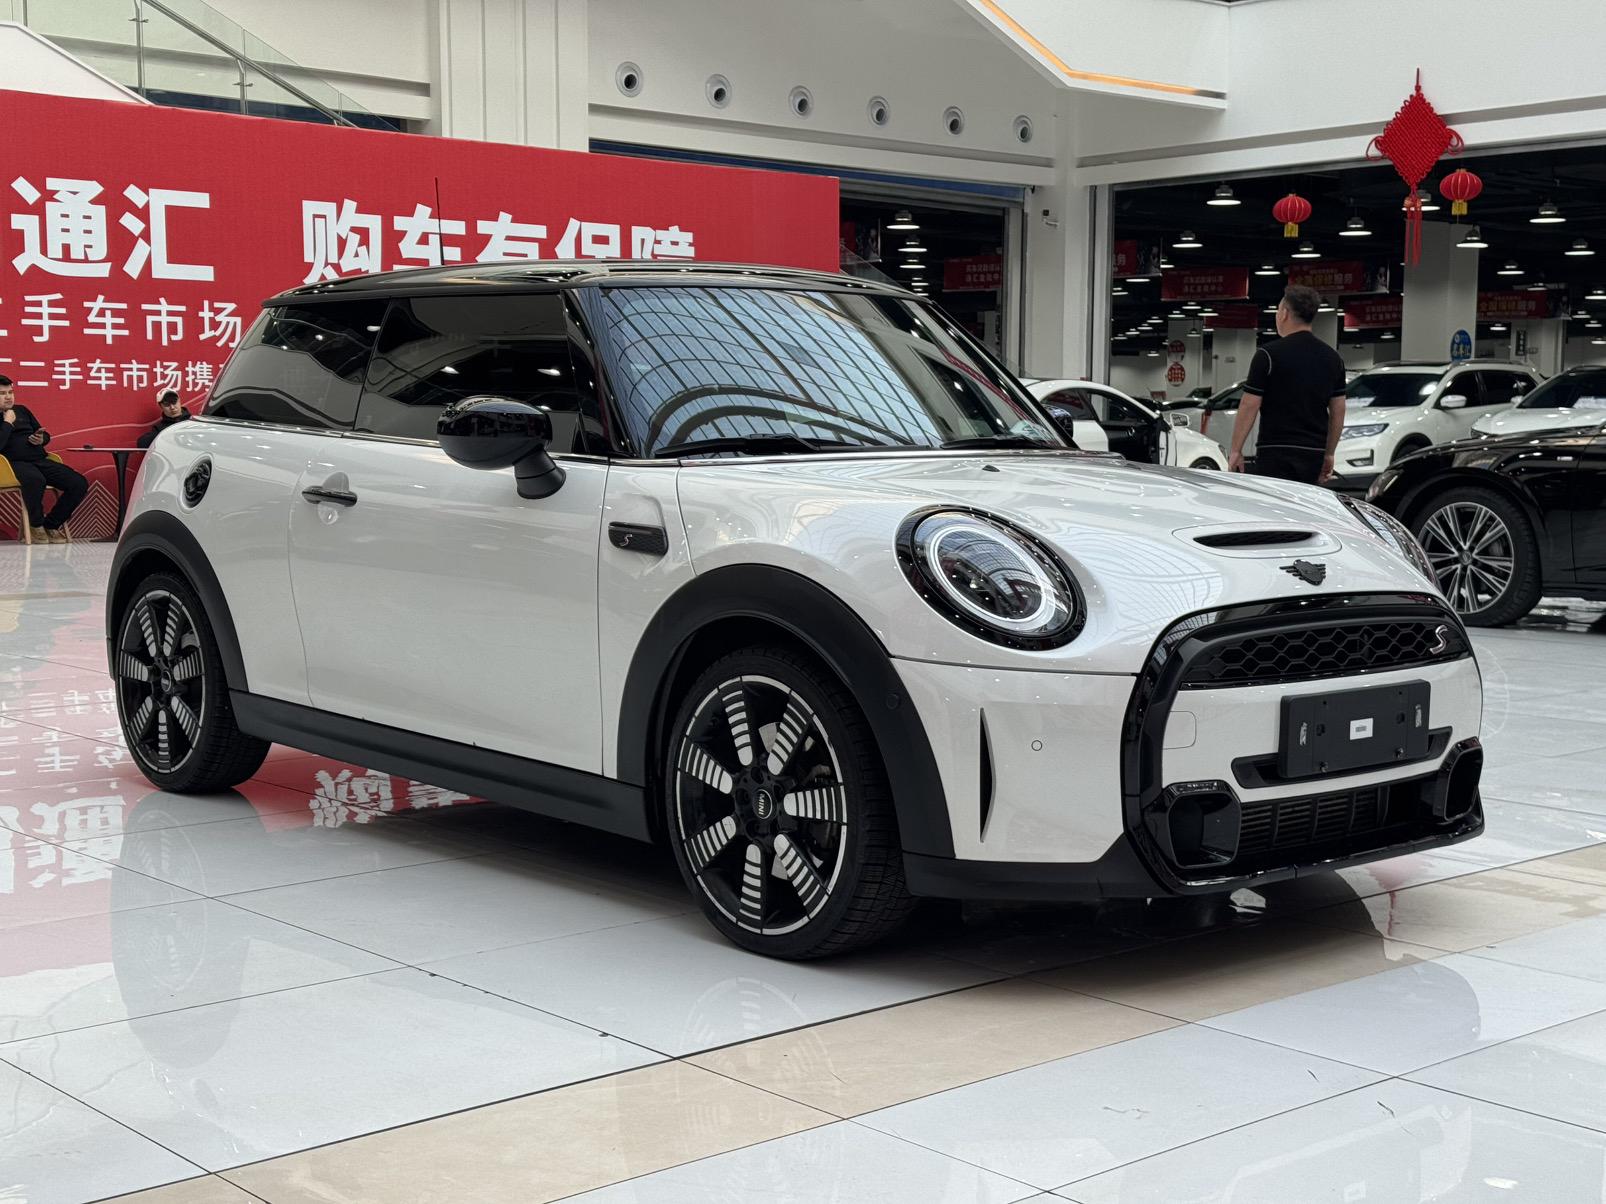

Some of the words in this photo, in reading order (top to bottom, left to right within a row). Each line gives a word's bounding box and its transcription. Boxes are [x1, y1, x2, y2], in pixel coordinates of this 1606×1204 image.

[10, 175, 215, 282] 通汇
[0, 293, 242, 348] 手车市场
[1429, 624, 1448, 655] S
